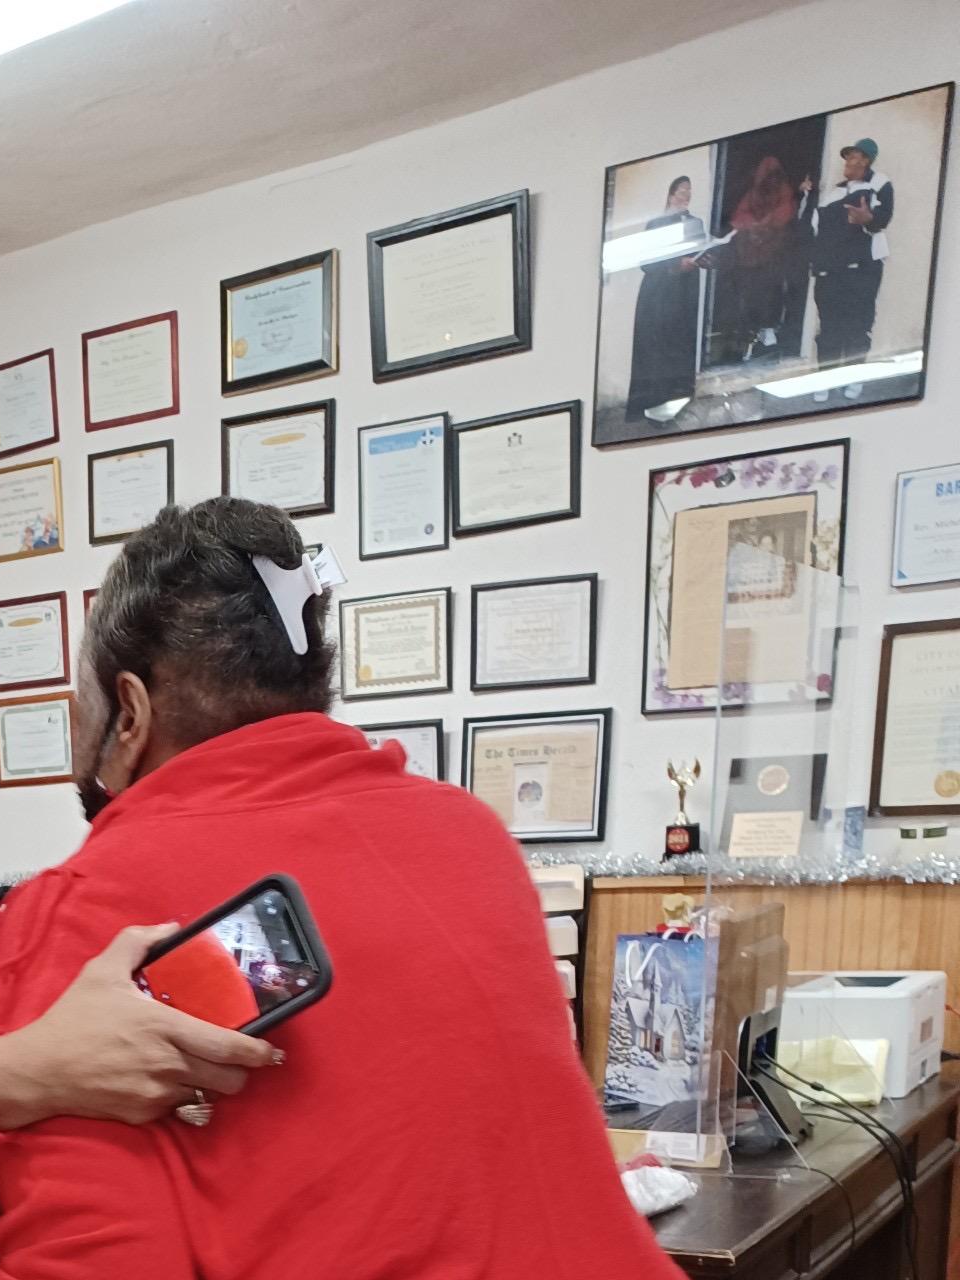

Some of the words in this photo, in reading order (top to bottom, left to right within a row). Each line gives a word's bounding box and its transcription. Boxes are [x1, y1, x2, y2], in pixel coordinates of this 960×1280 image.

[485, 749, 503, 759] The
[507, 747, 538, 758] Times
[543, 745, 577, 756] Herald
